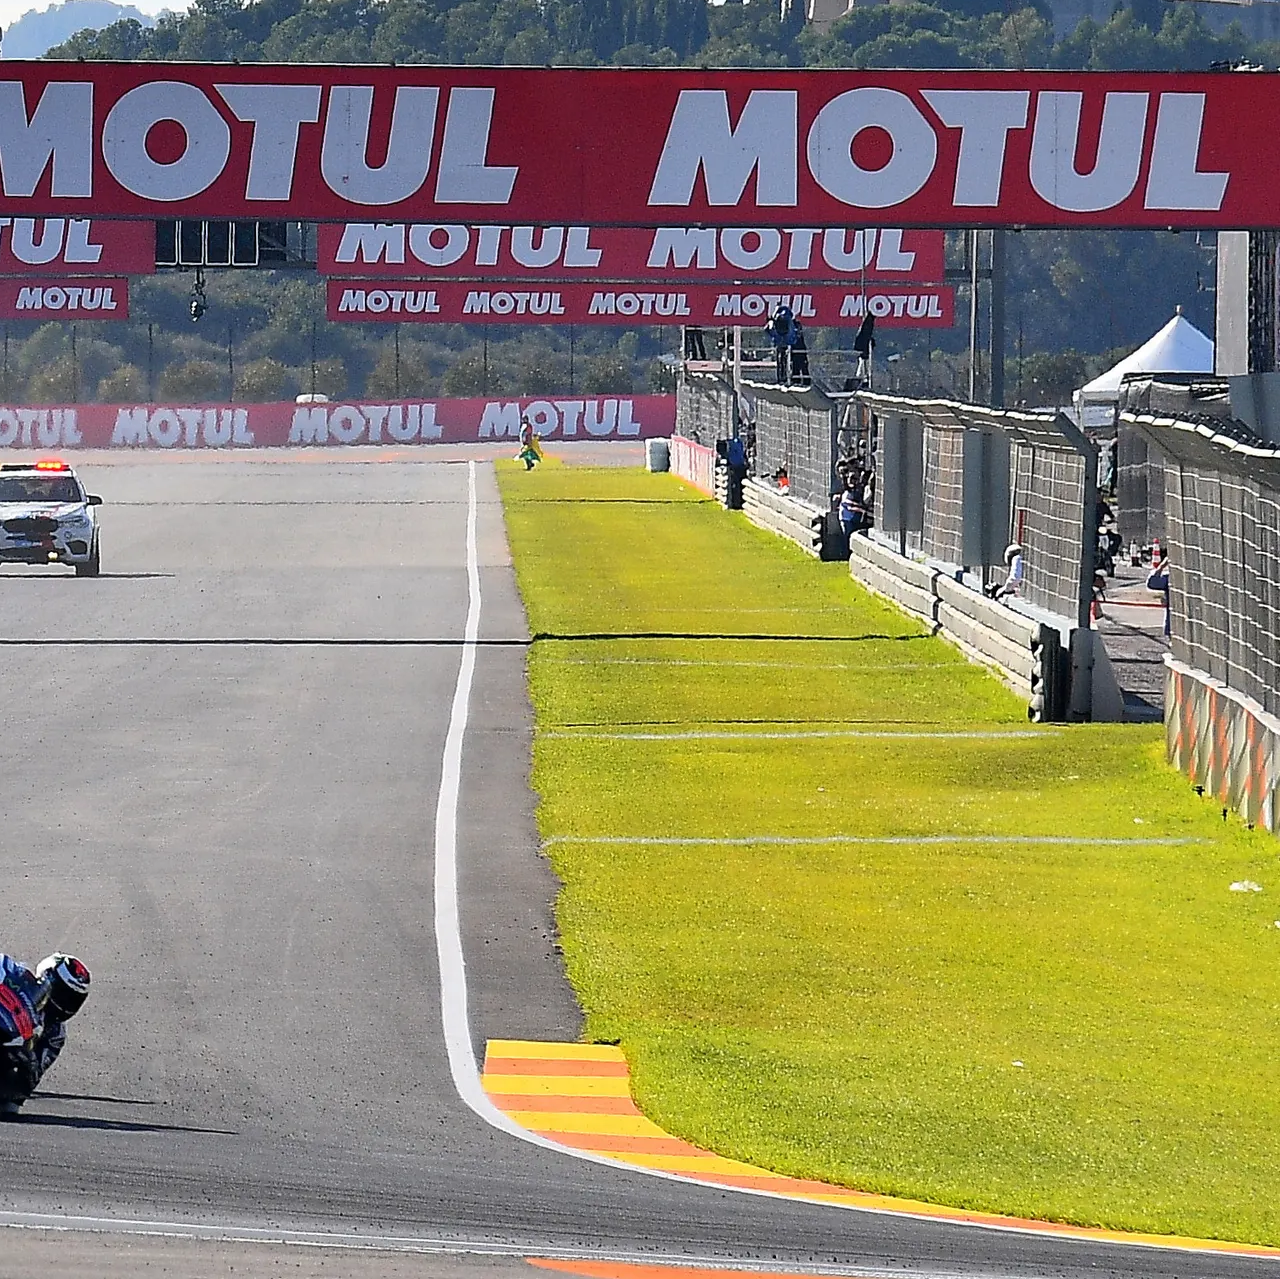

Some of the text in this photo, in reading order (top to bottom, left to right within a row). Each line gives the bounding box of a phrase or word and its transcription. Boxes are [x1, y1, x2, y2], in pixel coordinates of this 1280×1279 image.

[648, 87, 1231, 213] MOTUL
[335, 224, 916, 272] MOTUL MOTUL
[16, 287, 118, 311] MOTUL
[339, 289, 441, 315] MOTUL
[463, 292, 566, 316] MOTUL
[589, 293, 691, 317] MOTUL
[840, 295, 944, 320] MOTUL
[109, 407, 254, 447] MOTUL
[288, 403, 443, 445] MOTUL
[477, 399, 641, 438] MOTUL
